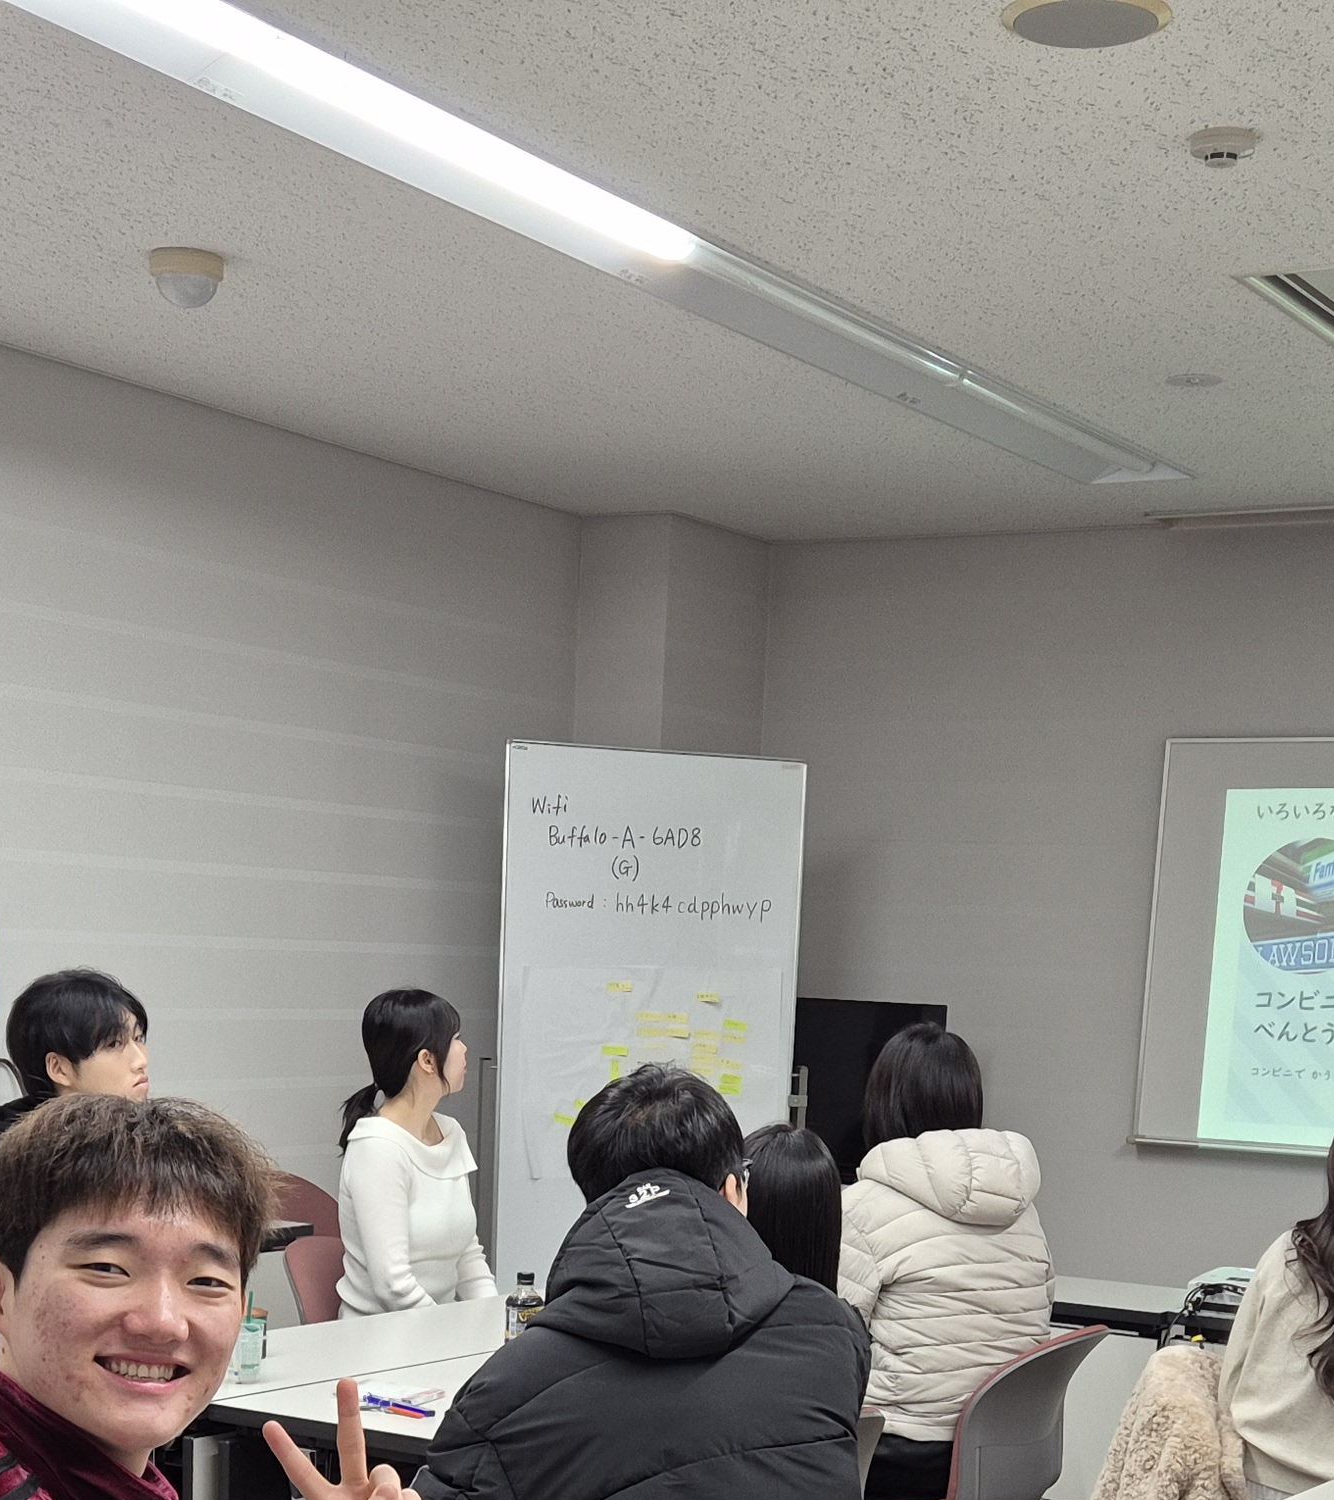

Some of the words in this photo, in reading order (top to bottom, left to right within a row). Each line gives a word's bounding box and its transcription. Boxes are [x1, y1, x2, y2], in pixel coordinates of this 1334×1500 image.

[531, 794, 569, 816] Wifi
[611, 855, 640, 882] (G)
[1311, 1068, 1332, 1081] かう
